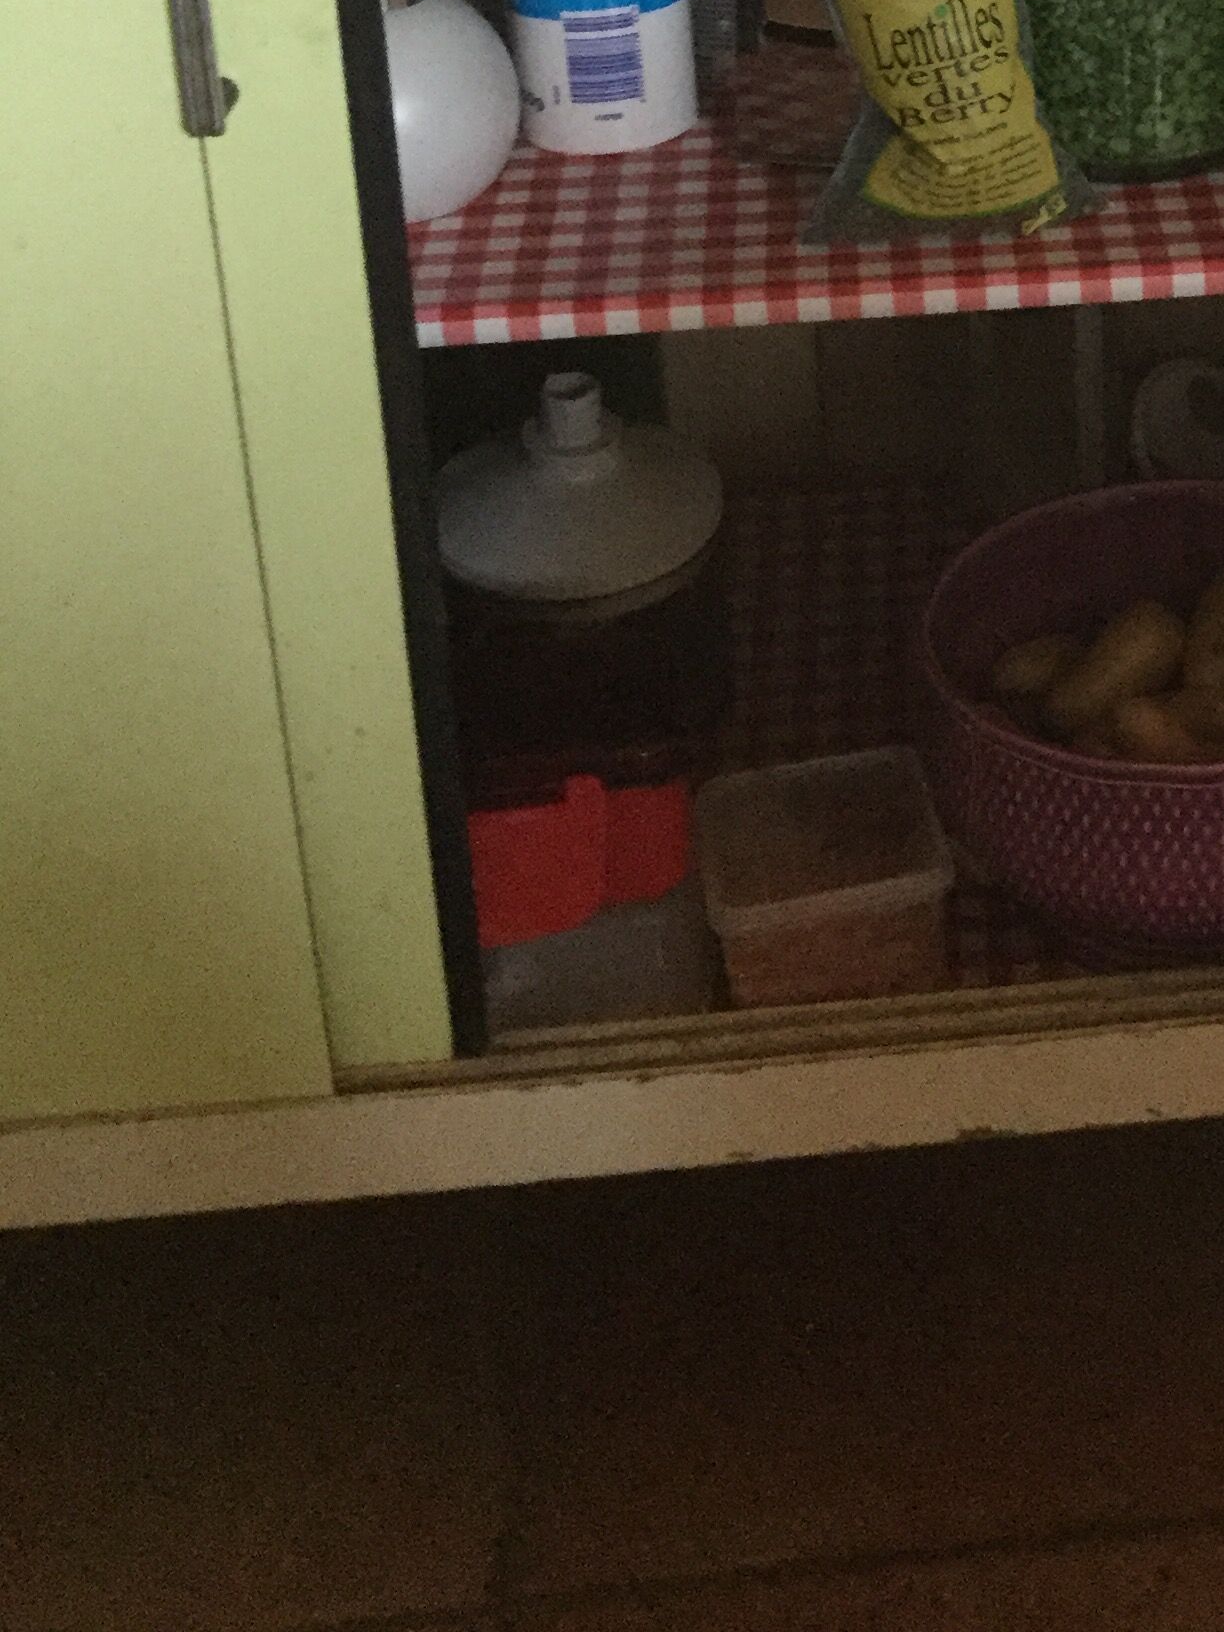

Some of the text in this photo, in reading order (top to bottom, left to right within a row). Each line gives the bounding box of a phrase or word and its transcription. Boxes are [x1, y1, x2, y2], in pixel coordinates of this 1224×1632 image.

[881, 46, 1009, 88] vertes
[896, 81, 1016, 128] Berry
[923, 80, 981, 108] du
